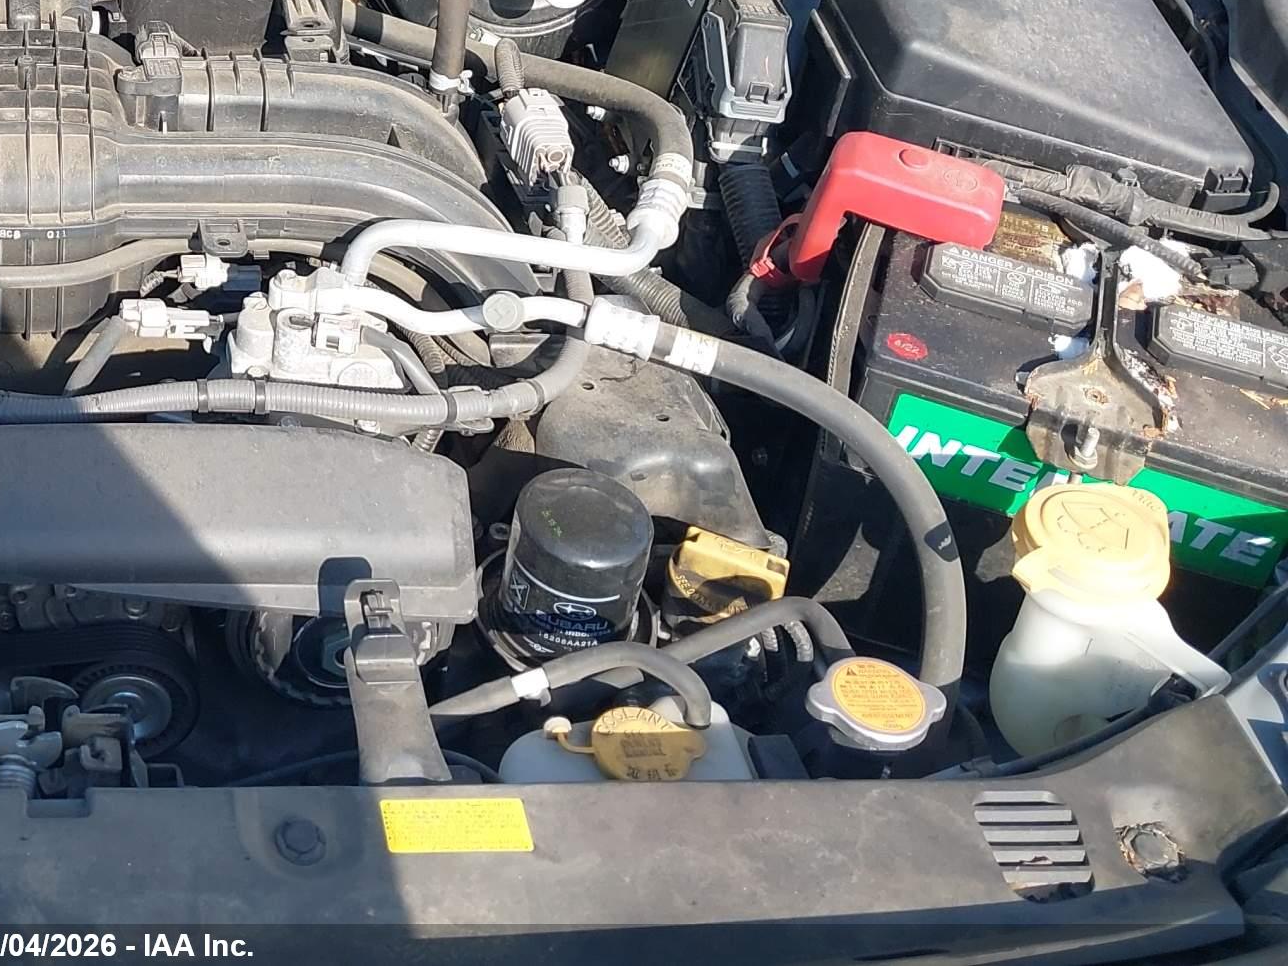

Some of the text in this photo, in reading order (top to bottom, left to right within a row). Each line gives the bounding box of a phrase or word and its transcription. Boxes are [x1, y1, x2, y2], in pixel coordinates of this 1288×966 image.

[961, 249, 1013, 268] DANGER
[1026, 267, 1073, 286] POISON
[535, 609, 608, 631] SUBARU
[595, 708, 671, 733] COOLANT
